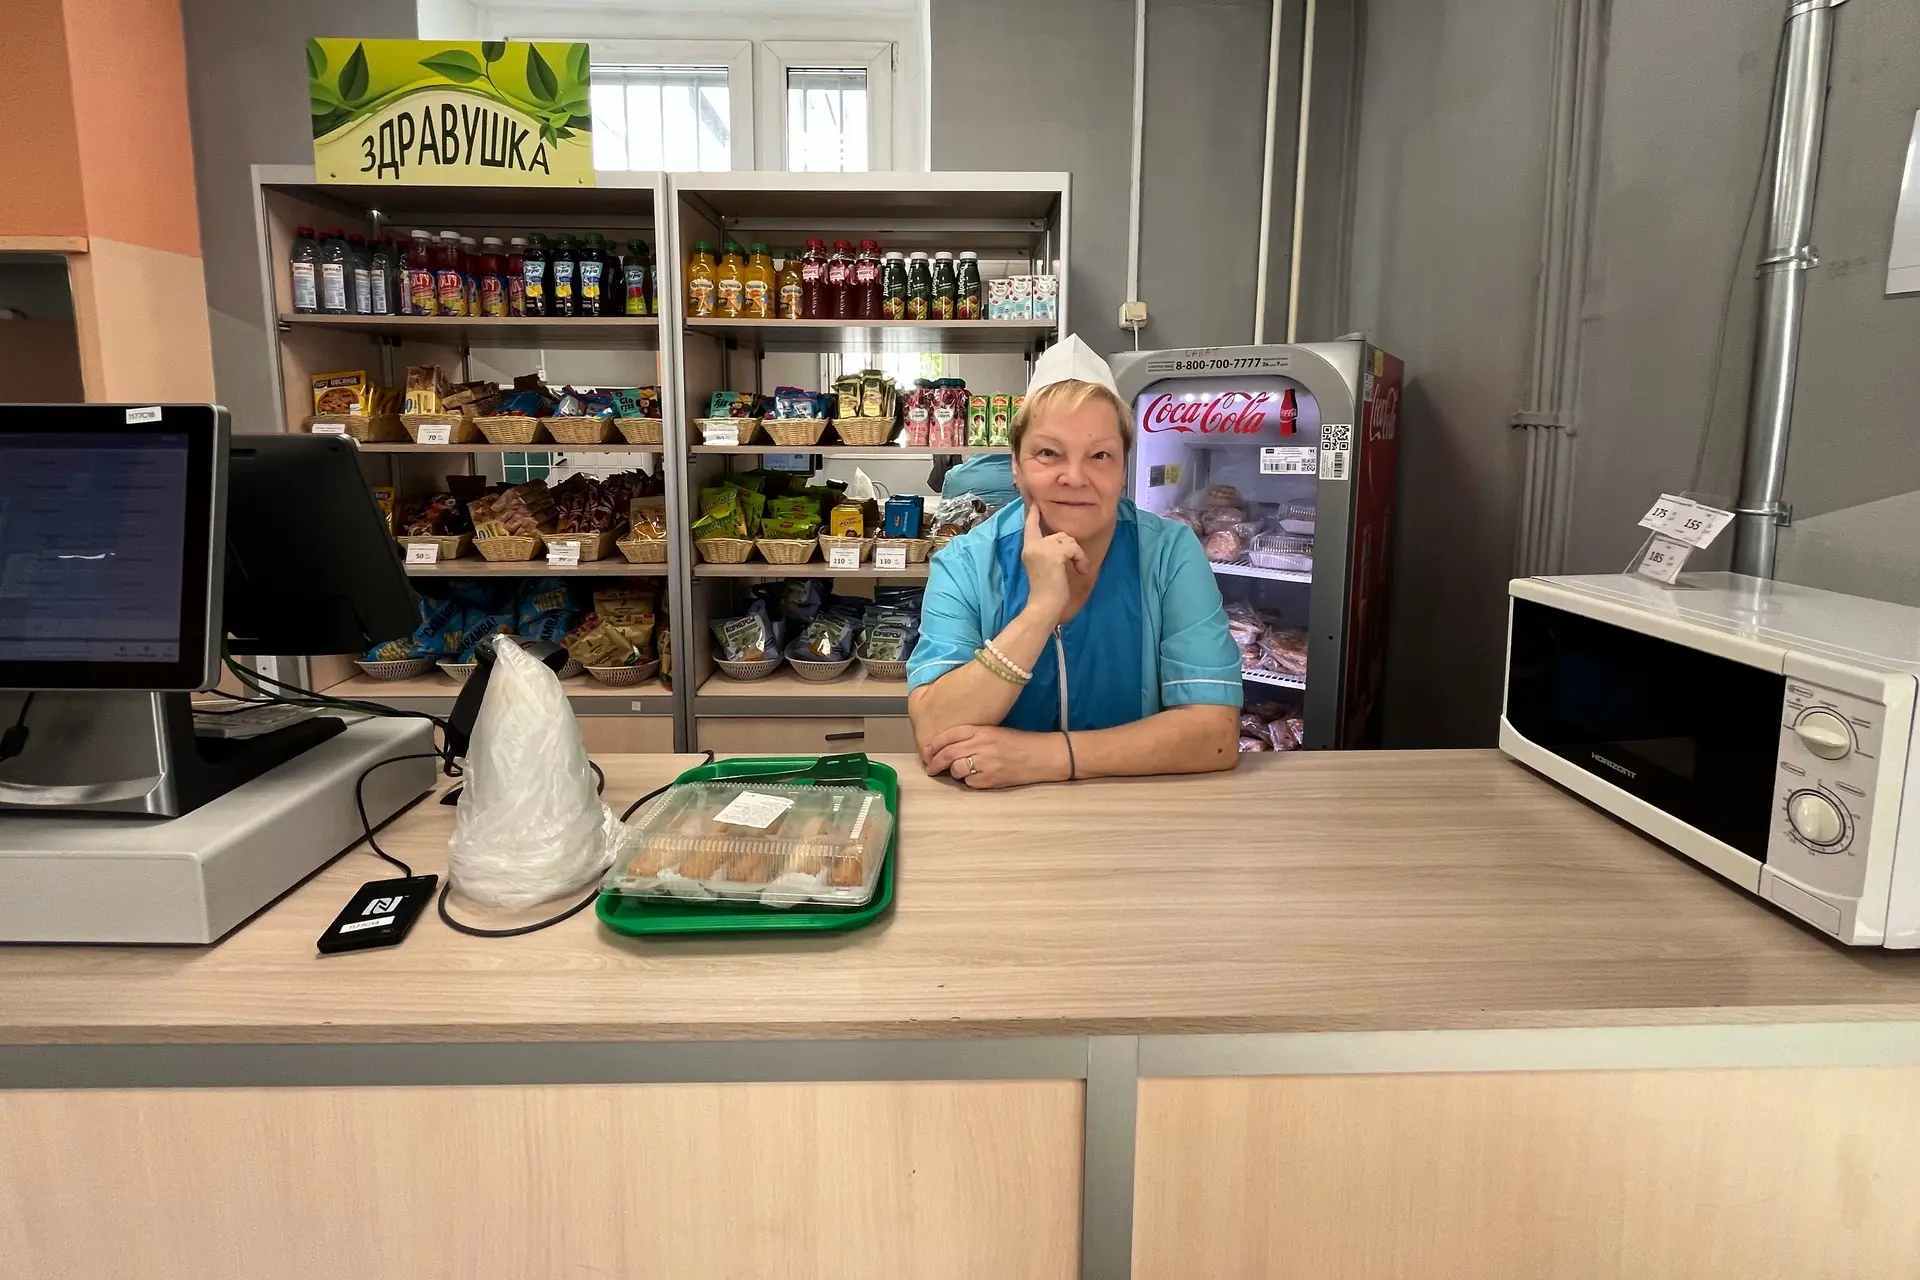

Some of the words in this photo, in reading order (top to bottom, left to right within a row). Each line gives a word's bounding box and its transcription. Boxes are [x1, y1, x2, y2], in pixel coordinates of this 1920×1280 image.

[360, 103, 550, 180] ЗДРАВУШКА
[958, 266, 967, 295] Добрый
[1175, 358, 1262, 371] 8-800-700-7777
[1143, 391, 1271, 434] Coca-Cola
[1652, 507, 1669, 518] 175
[1684, 519, 1703, 530] 155
[1648, 551, 1665, 563] 185
[1591, 751, 1637, 779] HORIZONT
